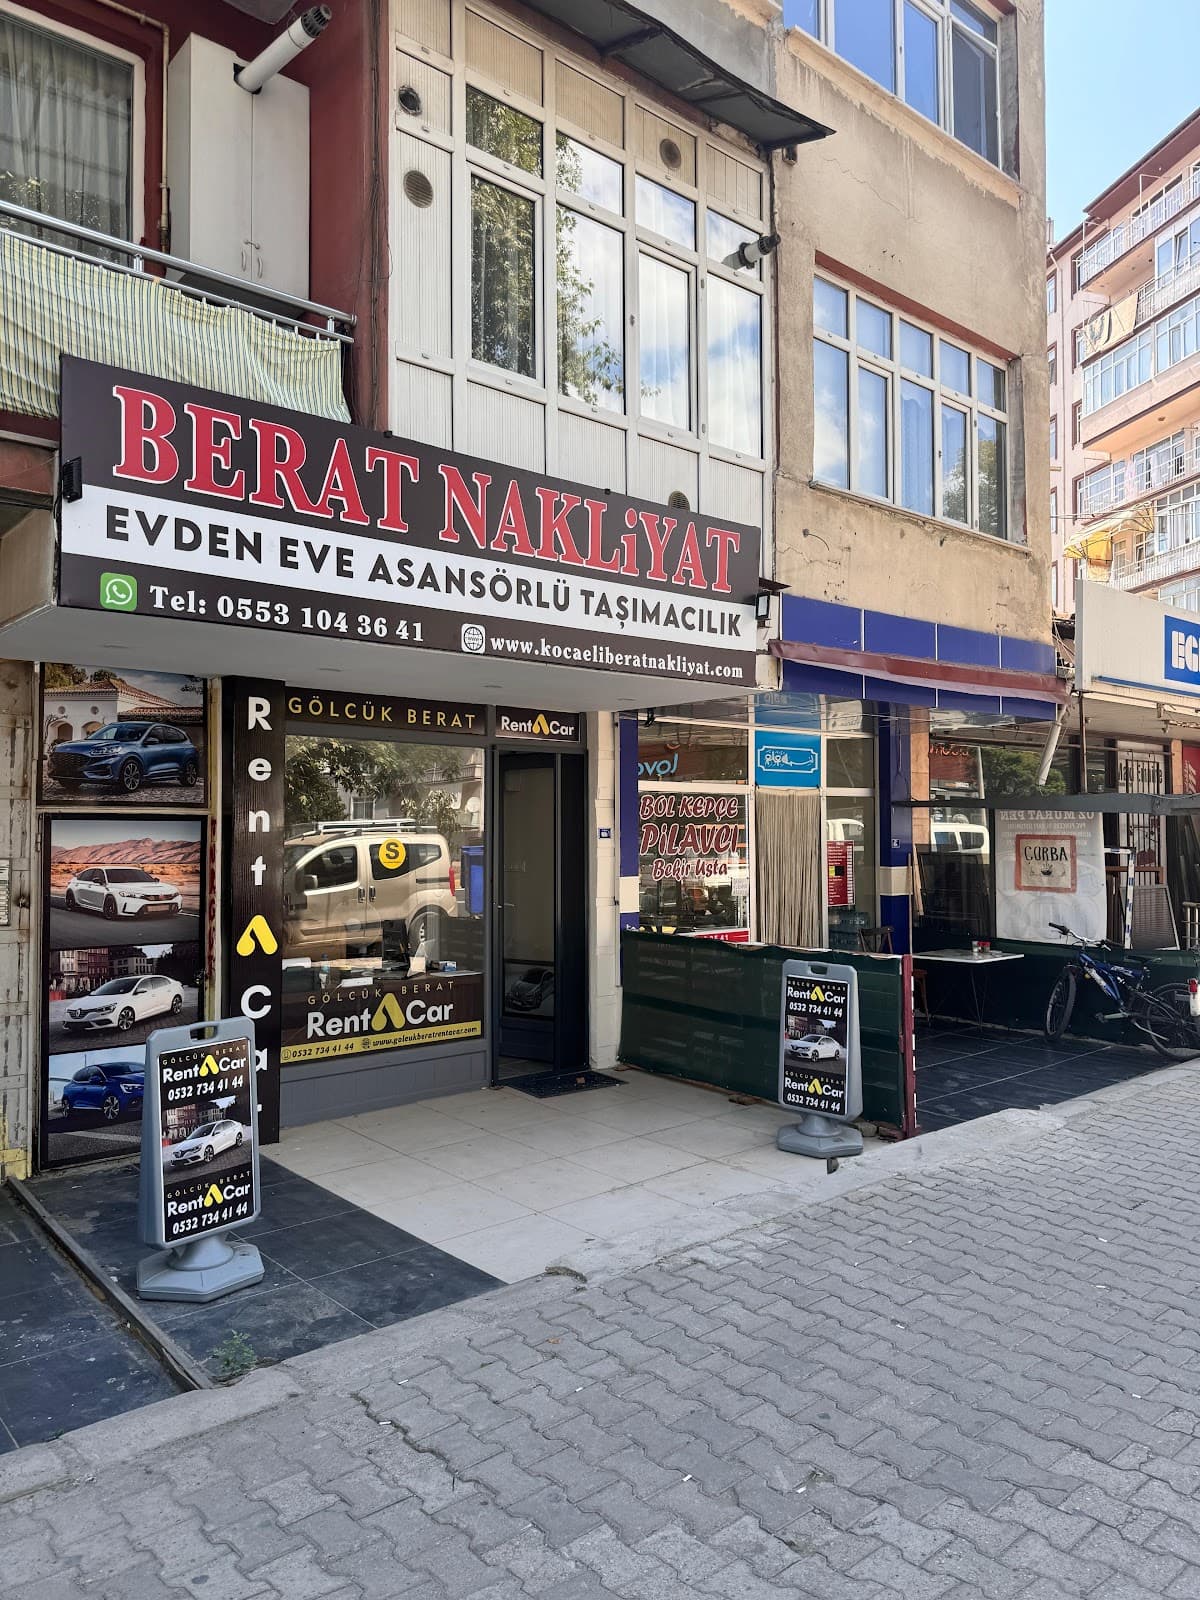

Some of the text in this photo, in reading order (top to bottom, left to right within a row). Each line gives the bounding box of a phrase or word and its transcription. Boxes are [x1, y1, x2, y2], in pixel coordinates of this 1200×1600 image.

[112, 385, 420, 533] BERAT
[106, 504, 741, 637] EVDEN EVE ASANSÖRLÜ TAŞIMACILIK
[150, 585, 424, 642] Tel: 0553 104 36 41
[490, 635, 744, 679] www.kocaeliberatnakliyat.com
[1171, 630, 1200, 673] EG
[288, 696, 475, 729] GÖLCÜK BERAT
[640, 794, 738, 822] BOL KEPÇE
[652, 858, 728, 881] Bekir Usta
[308, 981, 454, 1005] GÖLCÜK BERAT
[790, 1002, 842, 1018] 0532 734 41 44
[215, 1044, 246, 1056] BERAT
[292, 1042, 354, 1058] 0532 734 41 44
[168, 1075, 243, 1101] 0532 734 41 44
[787, 1093, 840, 1112] 0532 734 41 44
[172, 1202, 248, 1234] 0532 734 41 44
